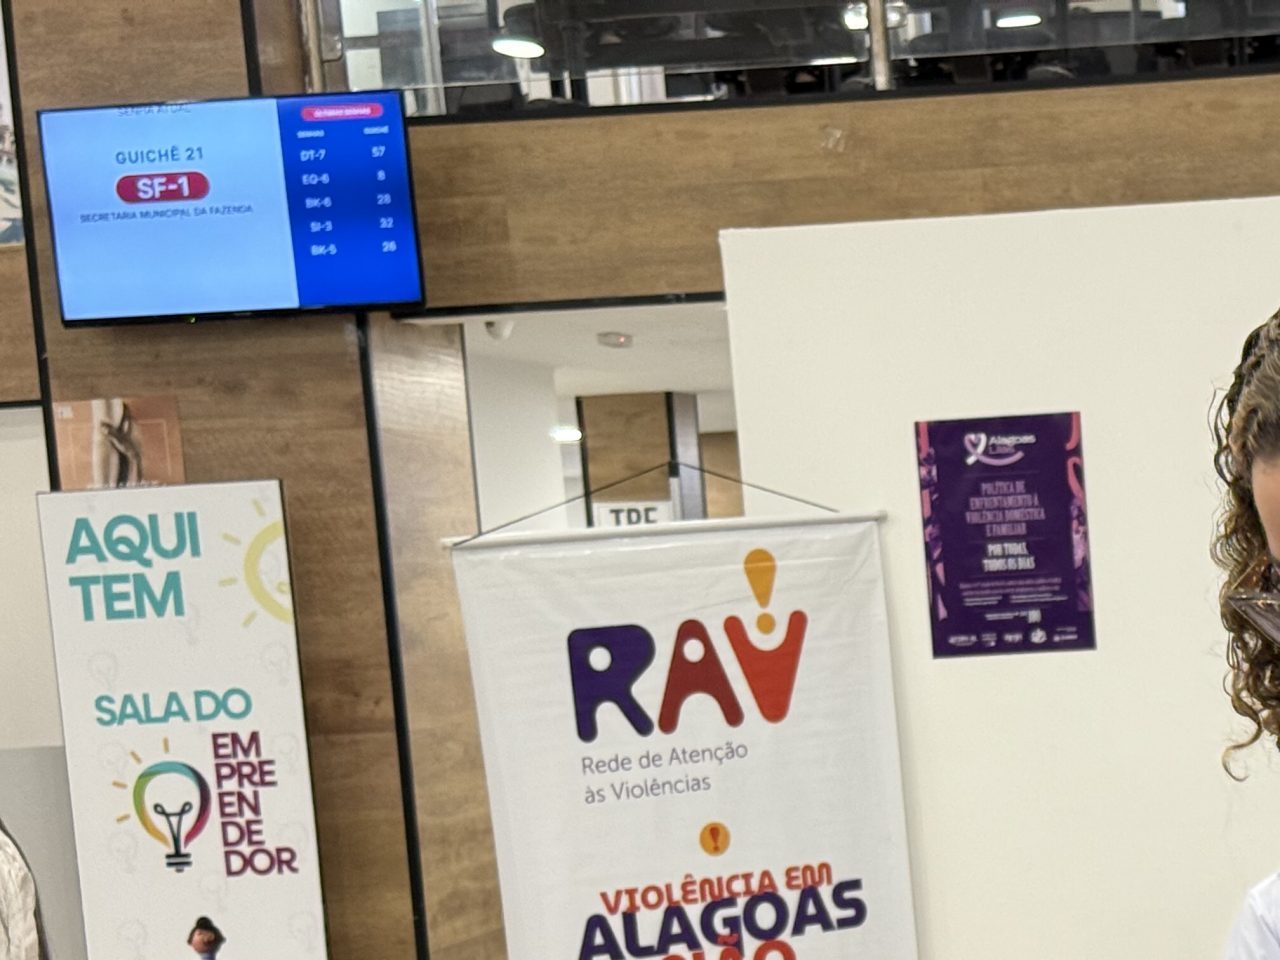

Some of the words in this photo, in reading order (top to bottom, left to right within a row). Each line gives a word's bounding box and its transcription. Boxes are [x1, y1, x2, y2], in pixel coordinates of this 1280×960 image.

[115, 145, 181, 165] GUICHÊ
[185, 146, 204, 162] 21
[136, 175, 191, 200] SF-1
[139, 207, 191, 220] MUNICIPAL
[65, 511, 202, 568] AQUI
[68, 570, 186, 622] TEM
[567, 610, 809, 743] RAV
[94, 690, 190, 726] SALA
[193, 687, 253, 722] DO
[211, 731, 262, 759] EM
[580, 753, 632, 776] Rede
[638, 748, 663, 770] de
[668, 740, 749, 768] Atenção
[215, 759, 277, 789] PRE
[584, 783, 607, 805] às
[609, 772, 712, 801] Violências
[218, 789, 262, 819] EN
[221, 819, 265, 848] DE
[225, 847, 299, 877] DOR
[600, 868, 779, 916] VIOLÊNCIA
[785, 861, 834, 890] EM
